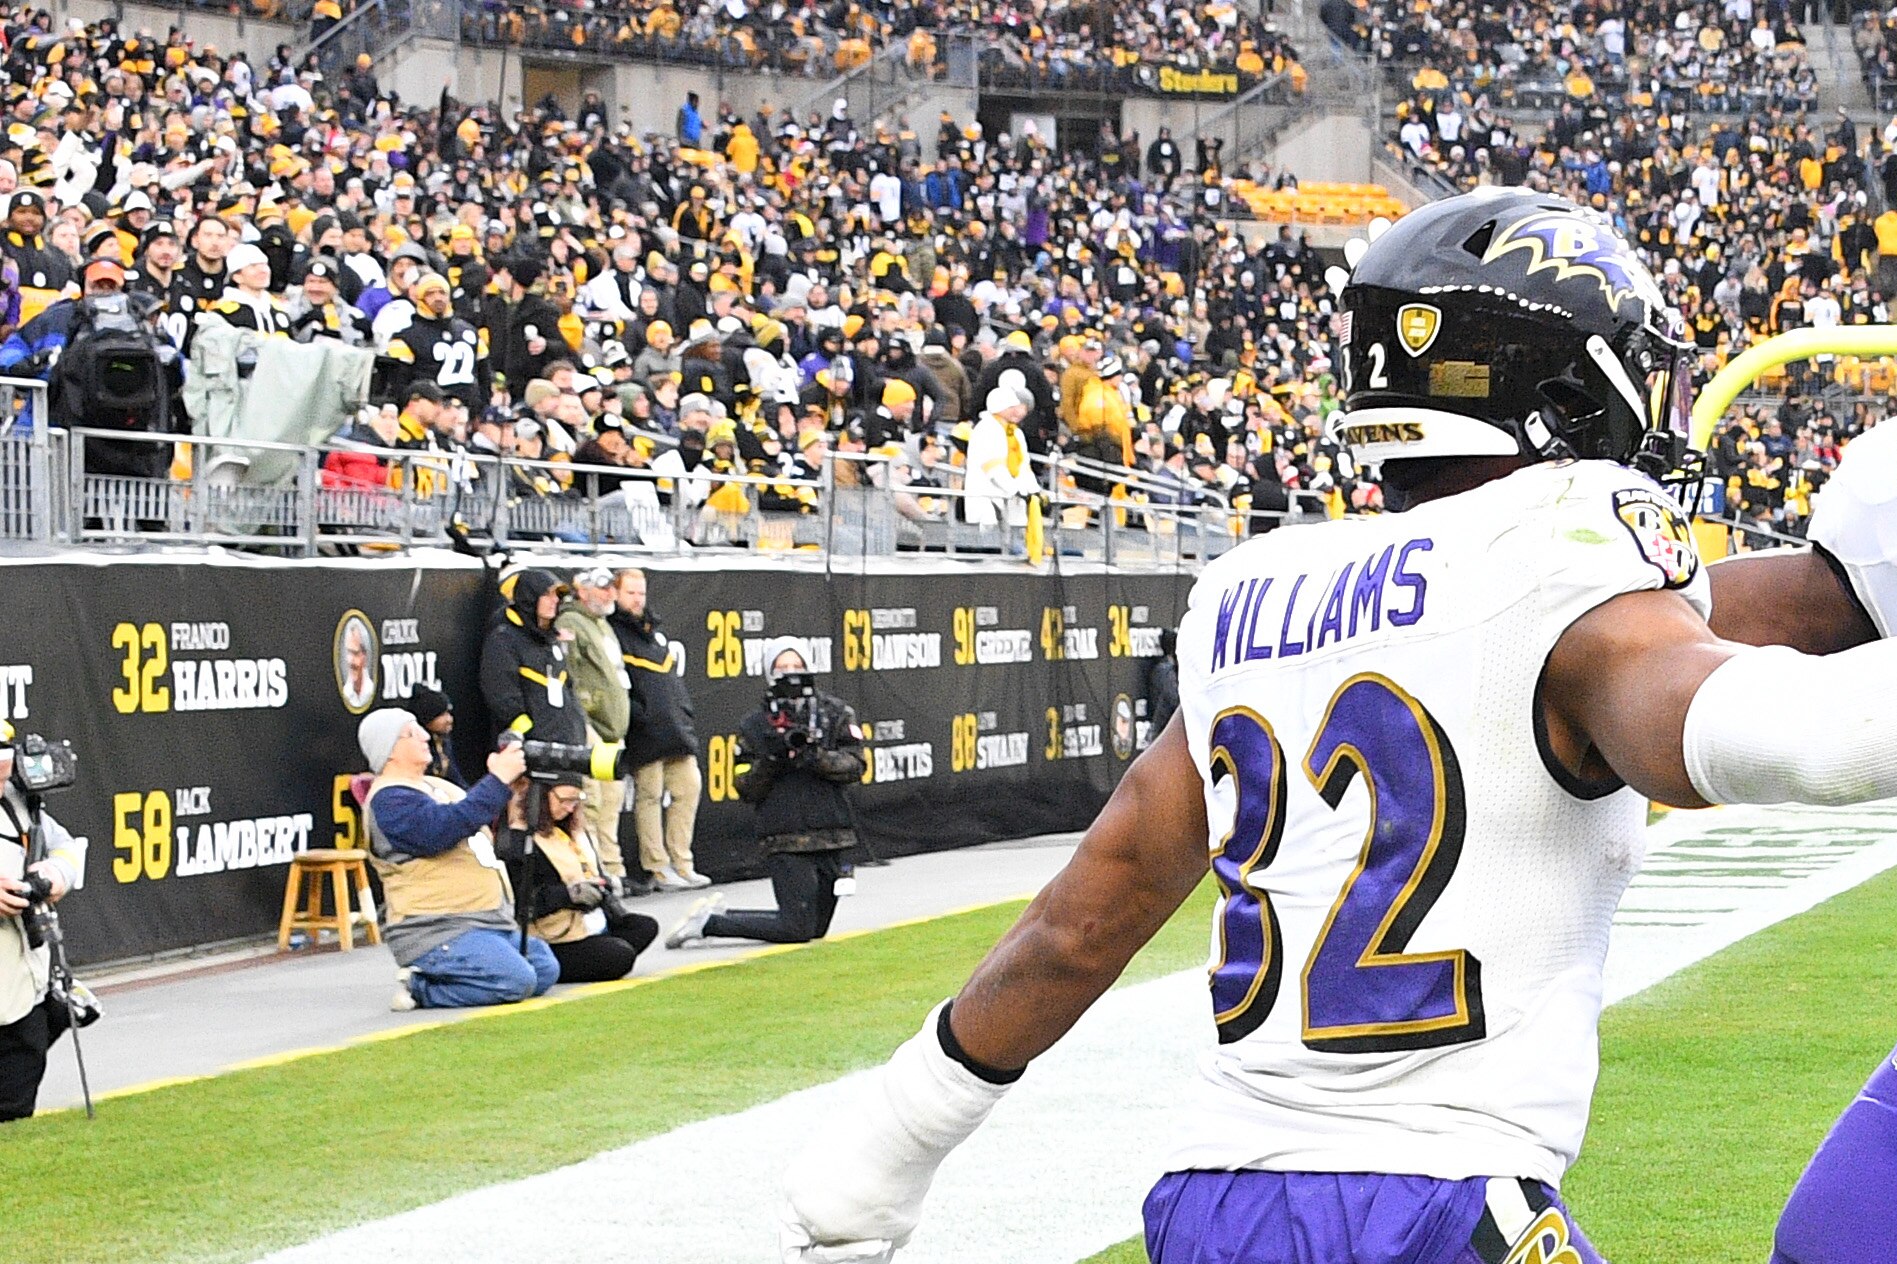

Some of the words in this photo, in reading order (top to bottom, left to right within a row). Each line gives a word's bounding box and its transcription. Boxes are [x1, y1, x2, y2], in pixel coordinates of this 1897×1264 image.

[432, 341, 475, 386] 22
[953, 607, 976, 666] 91
[1210, 538, 1434, 674] WILLIAMS
[111, 622, 170, 714] 32
[381, 651, 443, 700] NOLL
[706, 610, 742, 679] 26
[872, 632, 942, 671] DAWSON
[172, 658, 289, 712] HARRIS
[873, 742, 933, 784] BETTIS
[112, 790, 171, 884] 58
[175, 813, 313, 878] LAMBERT
[1207, 671, 1488, 1054] 32
